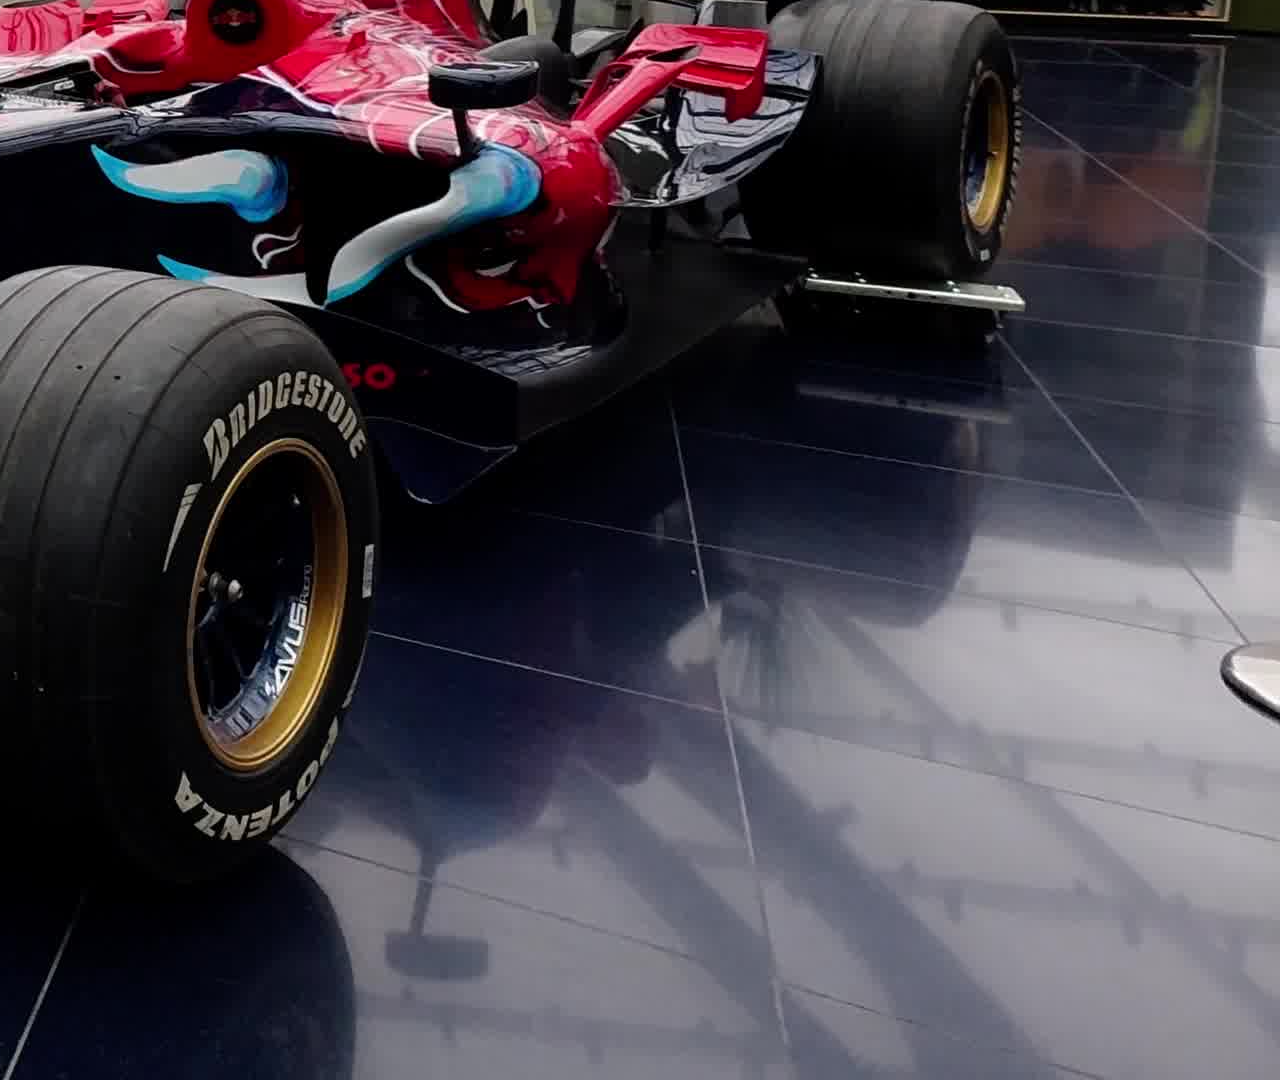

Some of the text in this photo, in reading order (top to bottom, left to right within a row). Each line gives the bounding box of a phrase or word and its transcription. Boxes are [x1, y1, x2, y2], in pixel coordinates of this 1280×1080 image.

[202, 370, 368, 482] BRIDGESTONE
[341, 362, 396, 390] SO
[272, 602, 309, 698] AVUS
[174, 715, 339, 841] POTENZA
